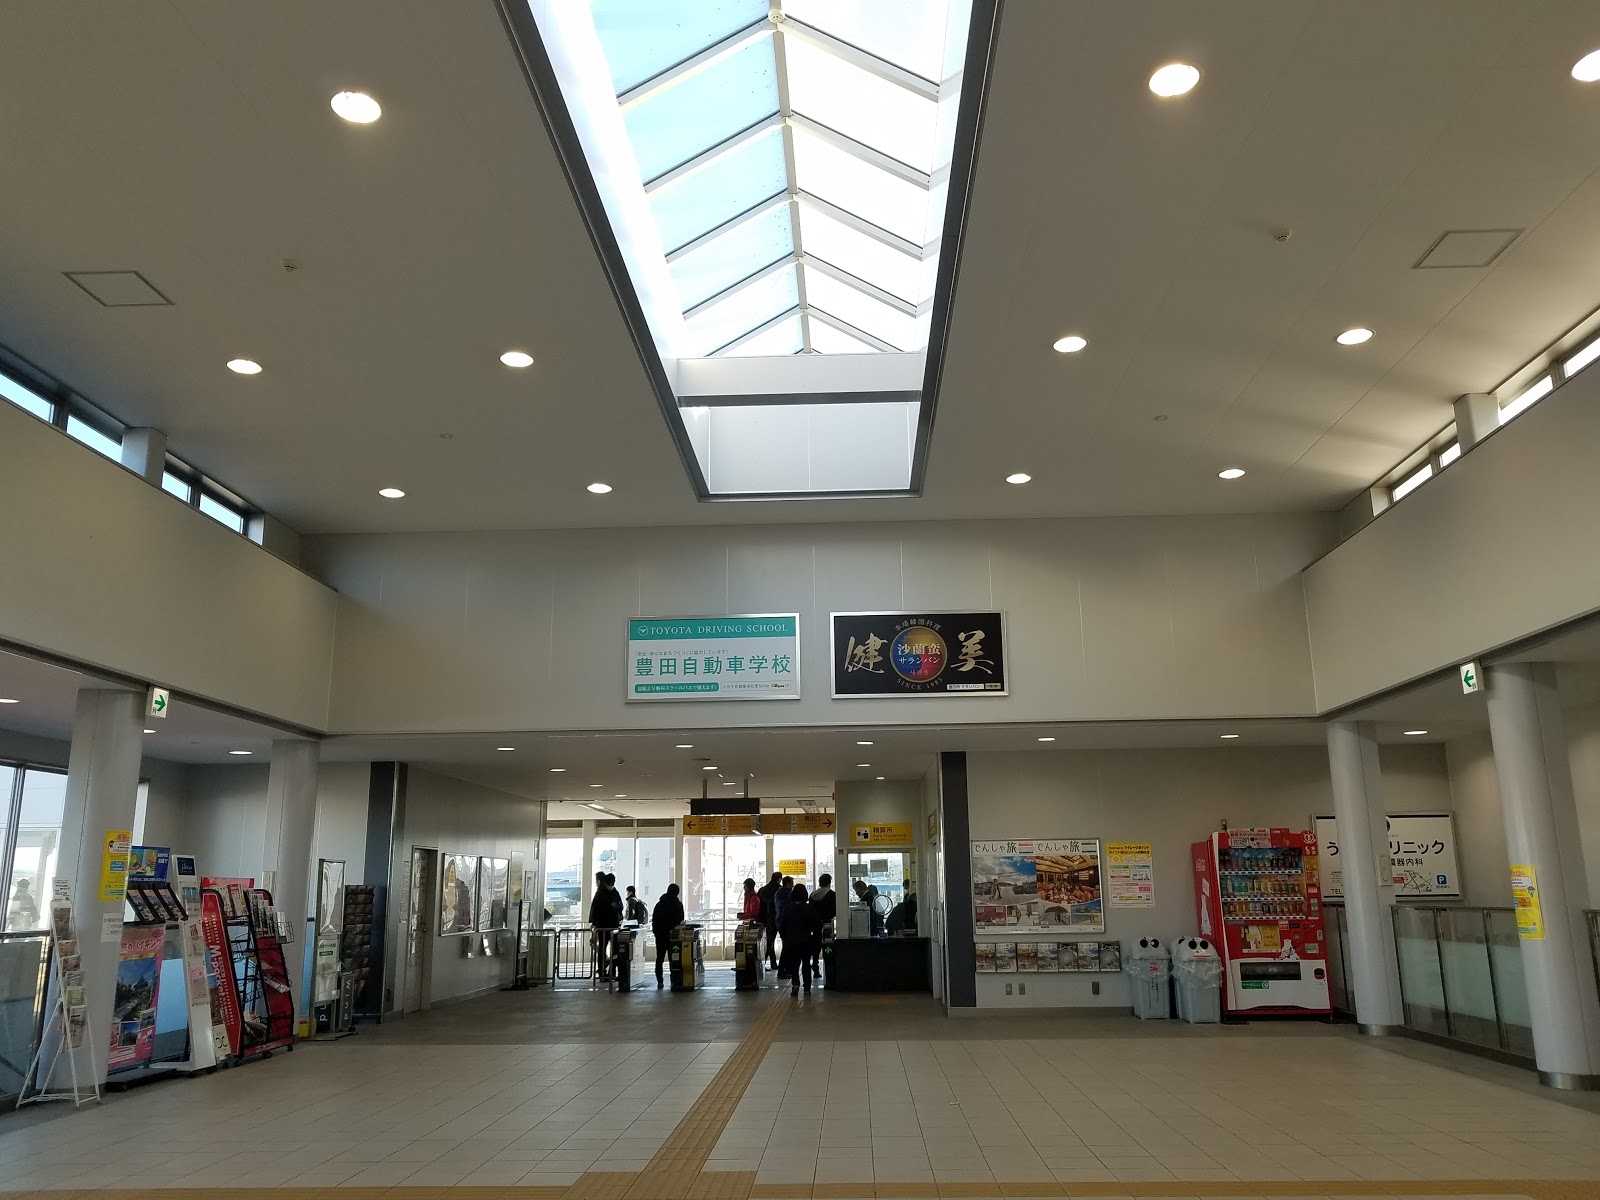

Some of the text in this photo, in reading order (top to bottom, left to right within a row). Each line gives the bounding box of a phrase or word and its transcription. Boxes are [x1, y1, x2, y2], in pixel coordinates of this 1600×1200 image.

[650, 623, 788, 636] TOYOTA DRIVING SCHOOL
[635, 655, 791, 677] 豊田自動車学校
